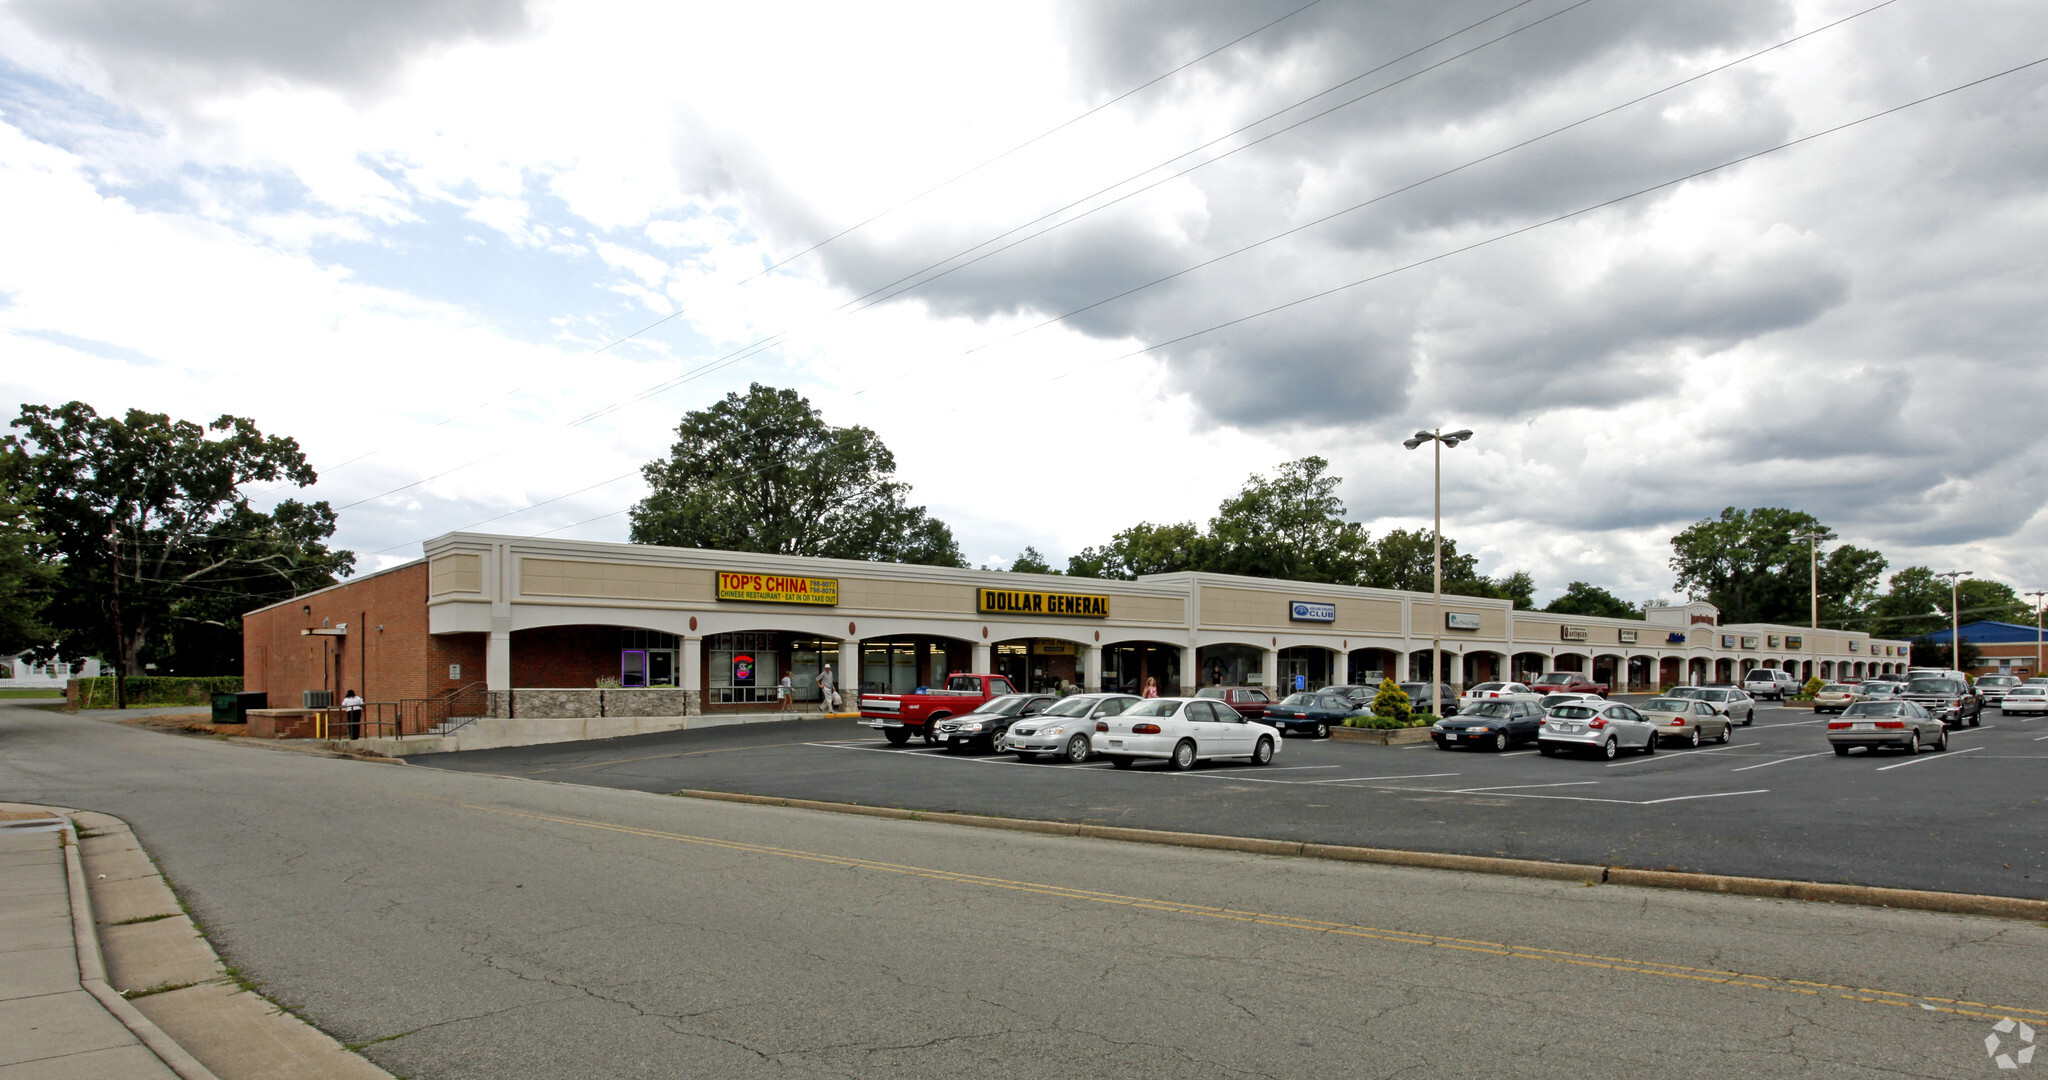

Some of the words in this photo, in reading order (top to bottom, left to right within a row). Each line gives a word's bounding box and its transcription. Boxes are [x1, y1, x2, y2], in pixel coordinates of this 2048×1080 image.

[721, 574, 762, 591] TOP'S
[766, 577, 808, 593] CHINA
[720, 590, 745, 599] CHINESE
[746, 592, 781, 600] RESTAURANT
[811, 595, 825, 603] TAKE
[986, 591, 1042, 612] DOLLAR
[1048, 595, 1107, 615] GENERAL
[1309, 610, 1334, 618] CLUB
